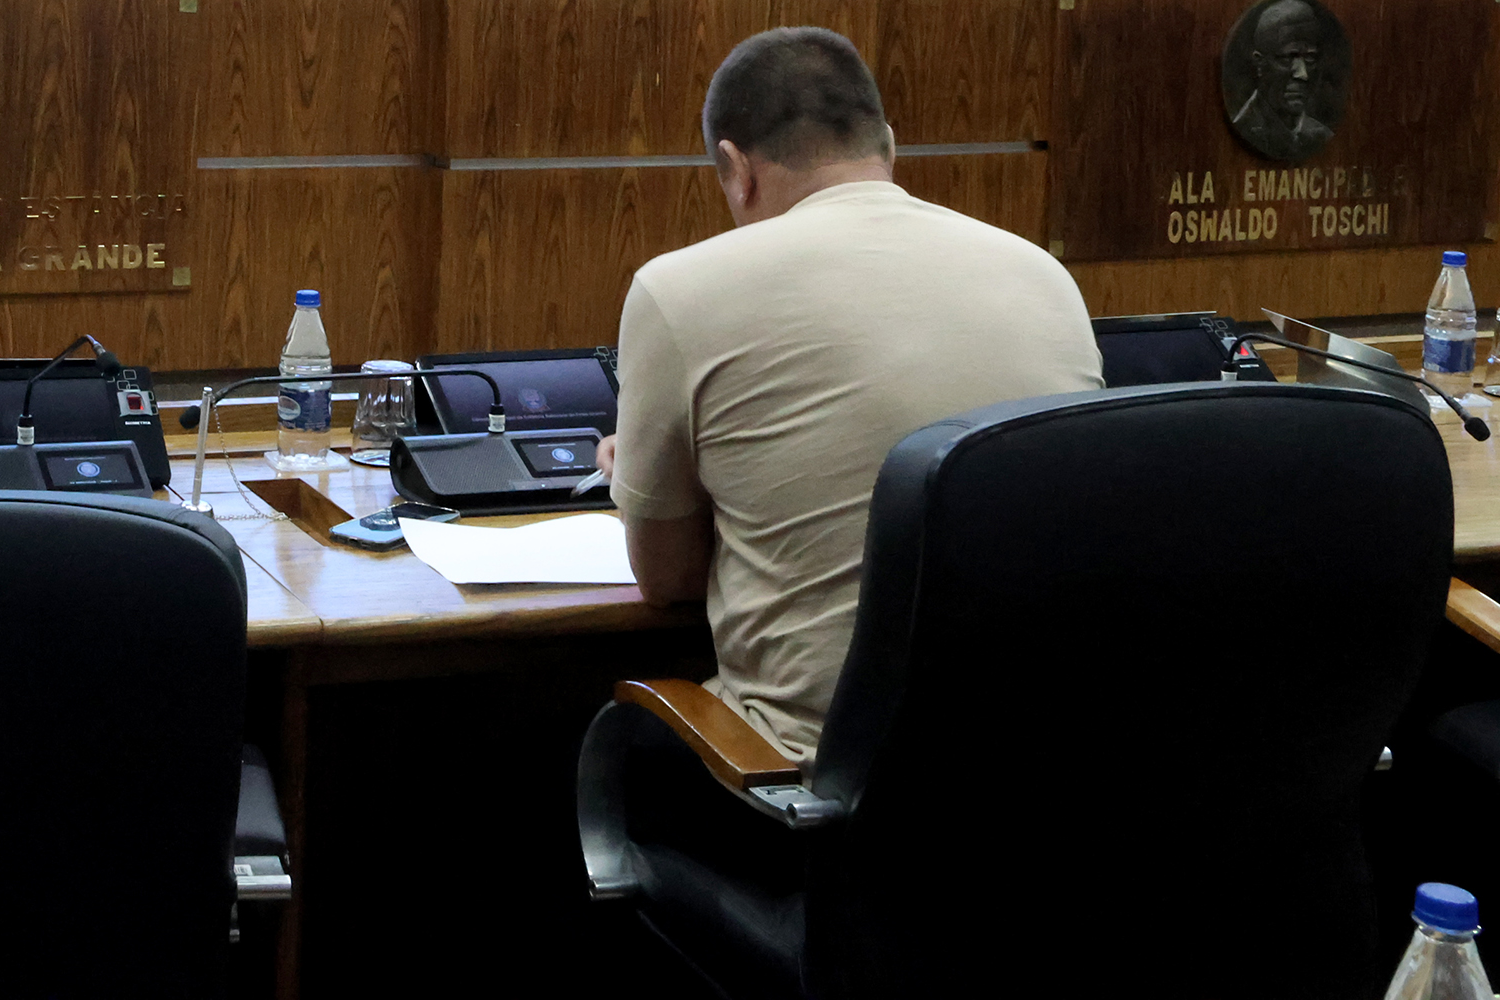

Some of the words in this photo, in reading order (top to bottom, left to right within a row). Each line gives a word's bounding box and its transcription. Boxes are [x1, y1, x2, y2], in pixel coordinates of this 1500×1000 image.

[1167, 170, 1215, 204] ALA
[1167, 206, 1278, 244] OSWALDO
[1309, 203, 1389, 238] TOSCHI
[19, 242, 165, 272] GRANDE
